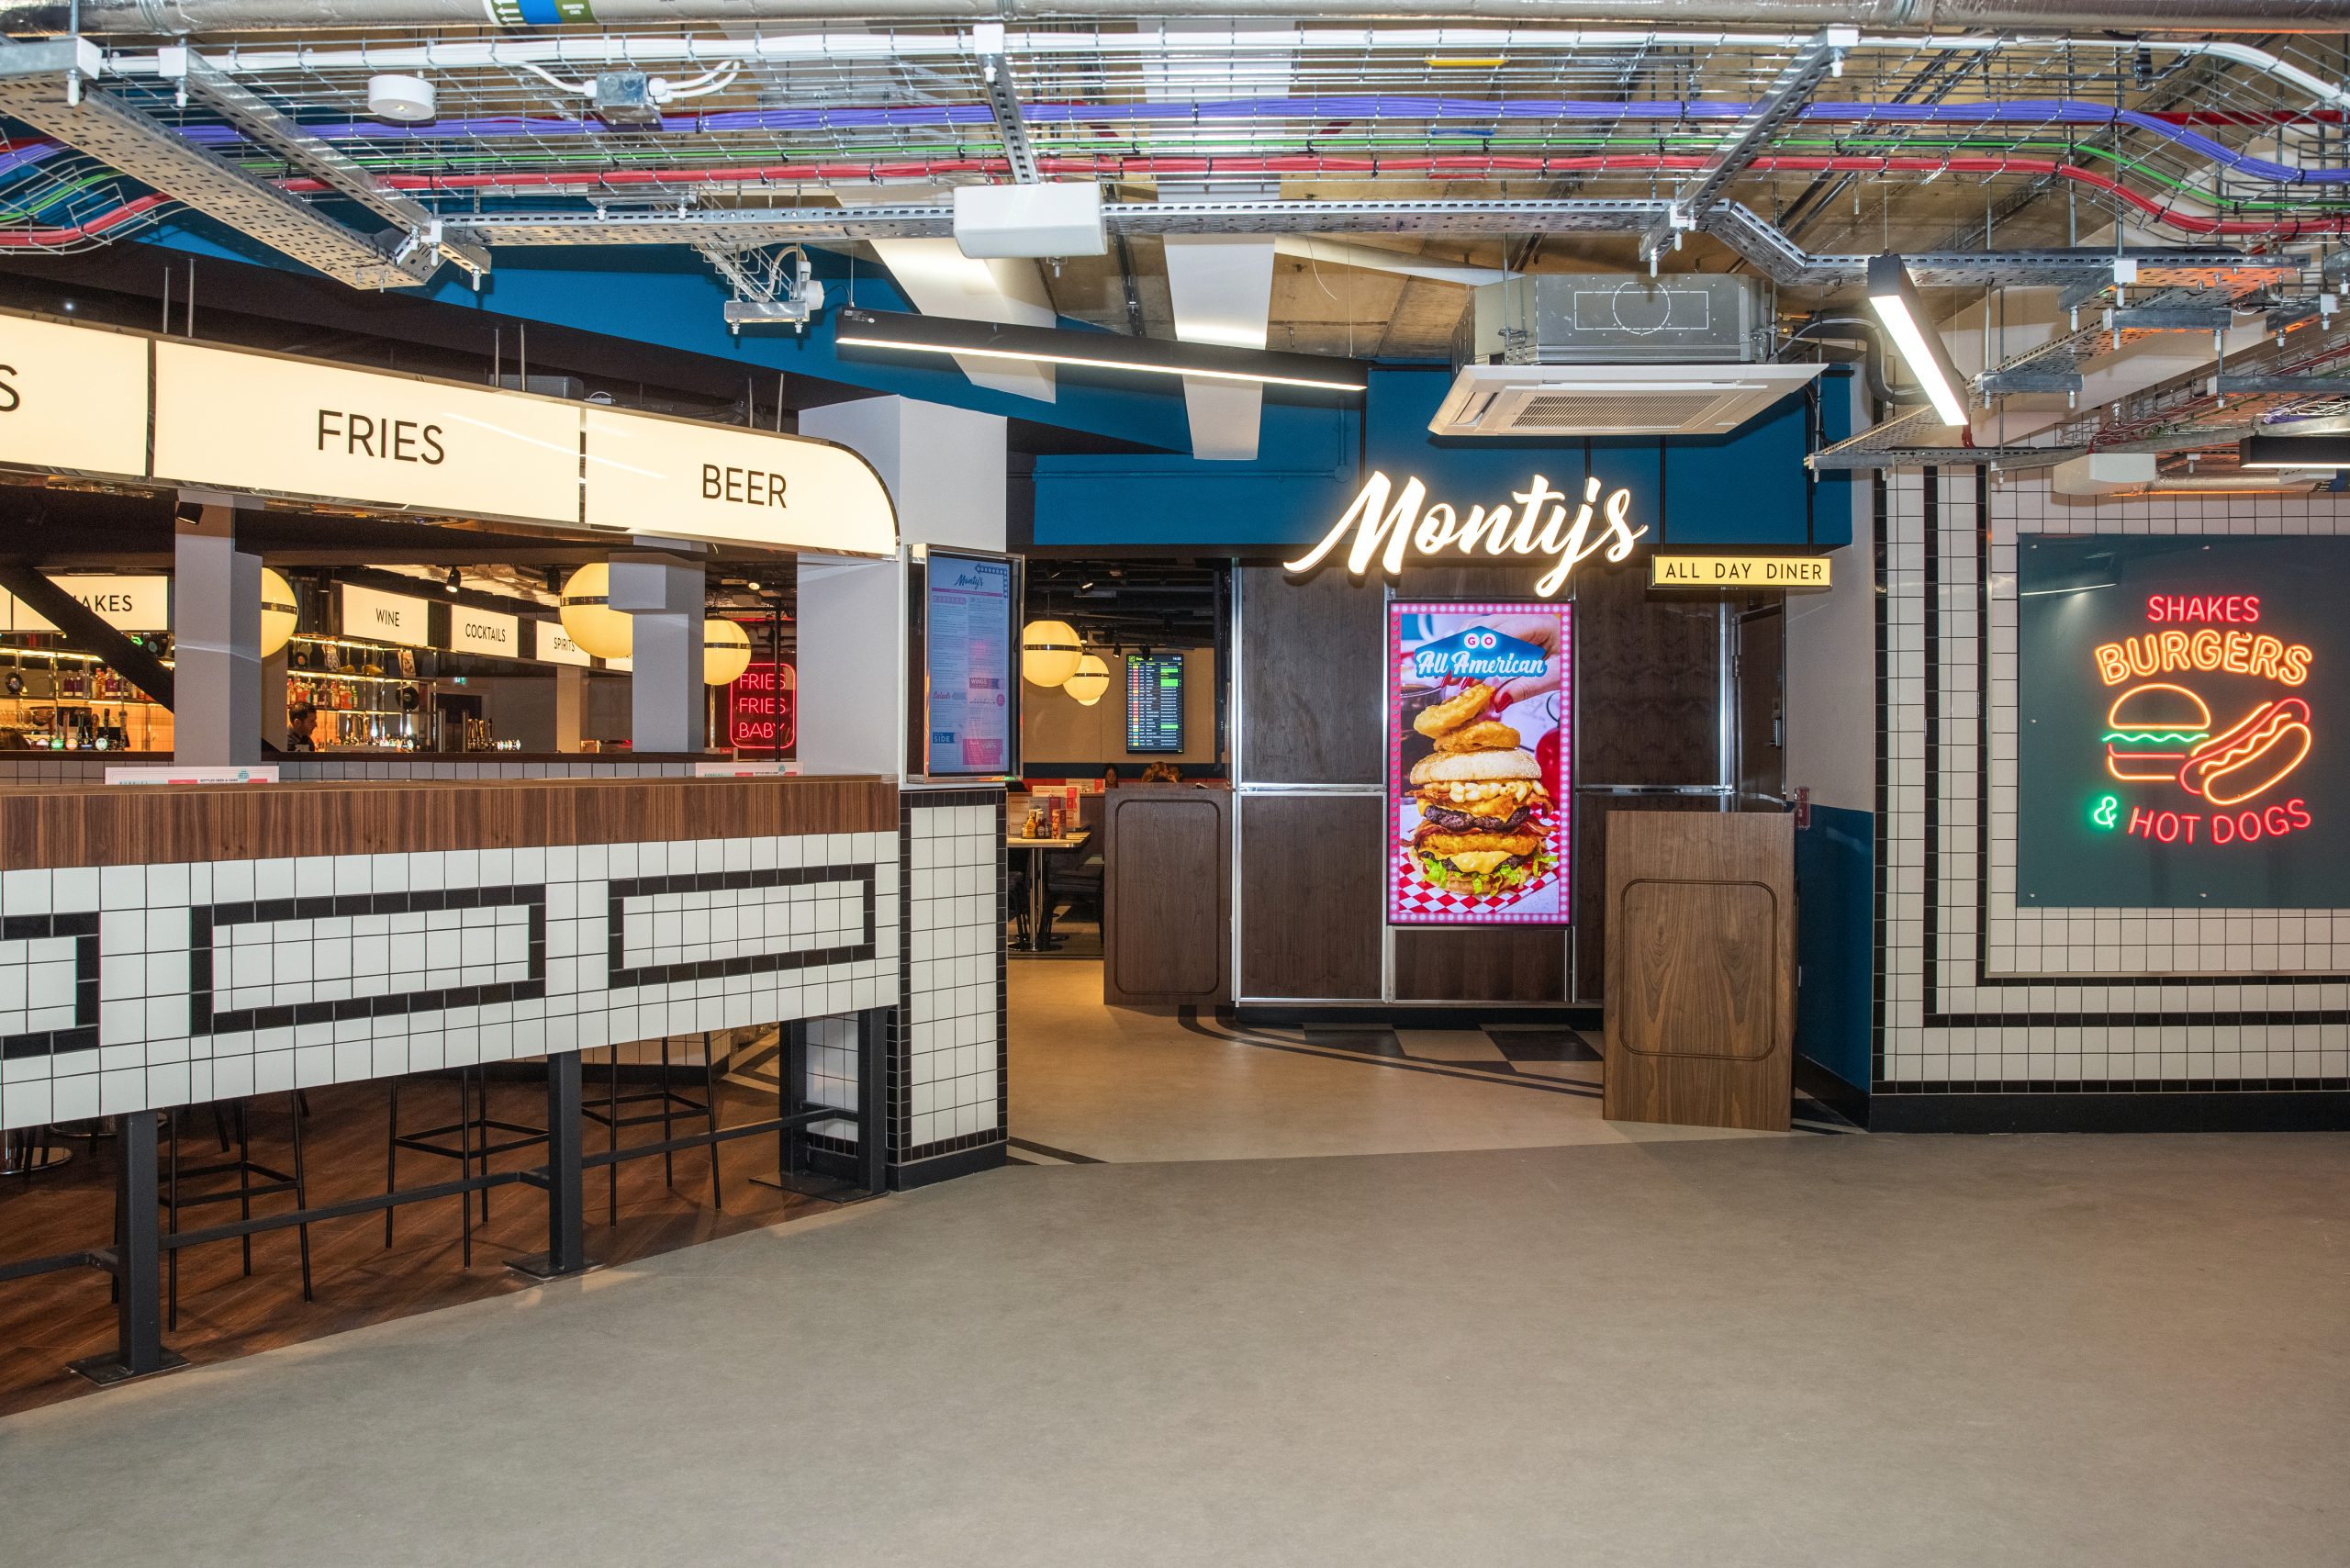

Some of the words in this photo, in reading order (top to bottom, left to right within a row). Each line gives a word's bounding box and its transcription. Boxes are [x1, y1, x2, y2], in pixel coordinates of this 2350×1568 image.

[318, 409, 445, 465] FRIES
[701, 463, 788, 509] BEER
[1282, 470, 1650, 599] Monty's
[954, 574, 984, 590] Monty's
[1664, 562, 1701, 579] ALL
[1714, 562, 1751, 579] DAY
[1765, 562, 1823, 581] DINER
[375, 608, 400, 627] WINE
[2147, 596, 2260, 622] SHAKES
[465, 622, 506, 643] COCKTAILS
[1466, 634, 1496, 648] GO
[554, 636, 576, 653] SPIRITS
[1416, 651, 1449, 676] All
[1450, 651, 1545, 675] American
[2094, 629, 2313, 686] BURGERS
[739, 673, 786, 689] FRIES
[739, 698, 786, 713] FRIES
[2093, 795, 2118, 828] &
[2127, 806, 2201, 844] HOT
[2211, 798, 2311, 844] DOGS
